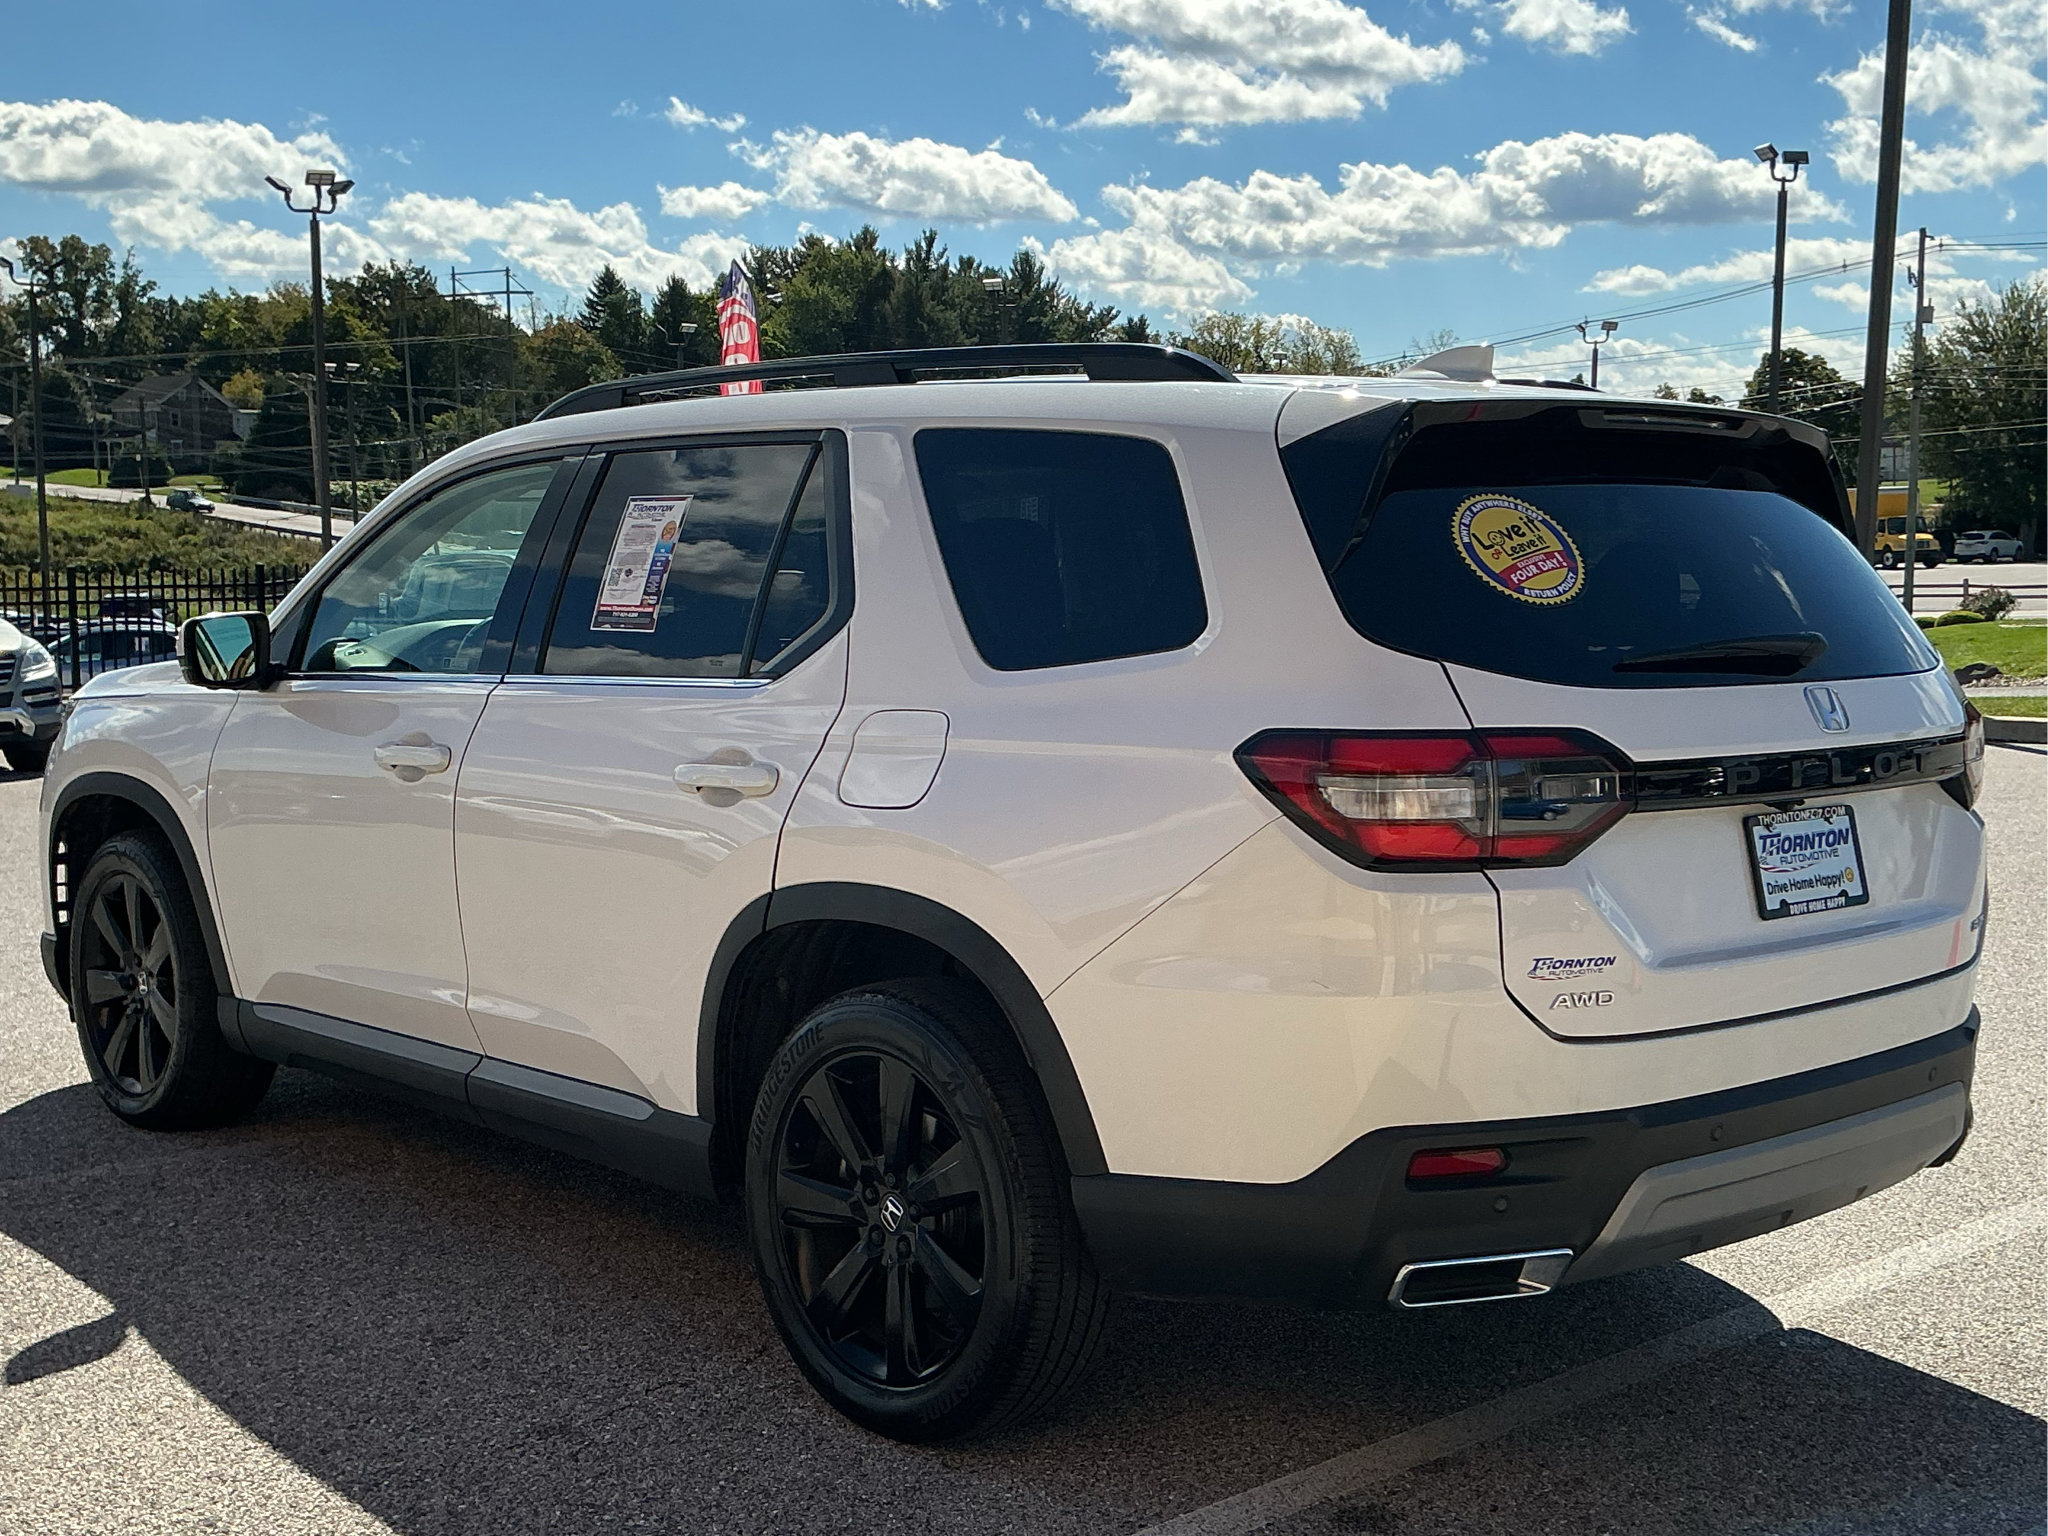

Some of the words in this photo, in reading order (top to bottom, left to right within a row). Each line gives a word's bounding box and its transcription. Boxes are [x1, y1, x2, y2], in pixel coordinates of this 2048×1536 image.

[632, 504, 675, 512] THORNTON
[1471, 500, 1515, 513] ANYWHERE
[1464, 510, 1474, 524] BUY
[1461, 526, 1470, 543] WHY
[1492, 550, 1503, 560] OR
[1501, 538, 1536, 557] Leave
[1535, 534, 1547, 545] it
[1510, 565, 1538, 583] FOUR
[1539, 552, 1568, 571] DAY!
[1517, 554, 1546, 568] EXCLUSIVE
[1524, 586, 1559, 597] RETURN
[1558, 571, 1577, 593] POLICY
[1726, 749, 1929, 795] PILOT
[1759, 828, 1849, 857] THORNTON
[1780, 848, 1840, 865] AUTOMOTIVE
[1766, 880, 1789, 895] Drive
[1790, 877, 1814, 891] Home
[1816, 870, 1845, 889] Happy!
[1790, 902, 1807, 915] DRIVE
[1809, 900, 1826, 912] HOME
[1827, 897, 1845, 909] HAPPY
[1532, 956, 1616, 970] THORNTON
[1548, 968, 1604, 976] AUTOMOTIVE
[1549, 990, 1615, 1009] AWD
